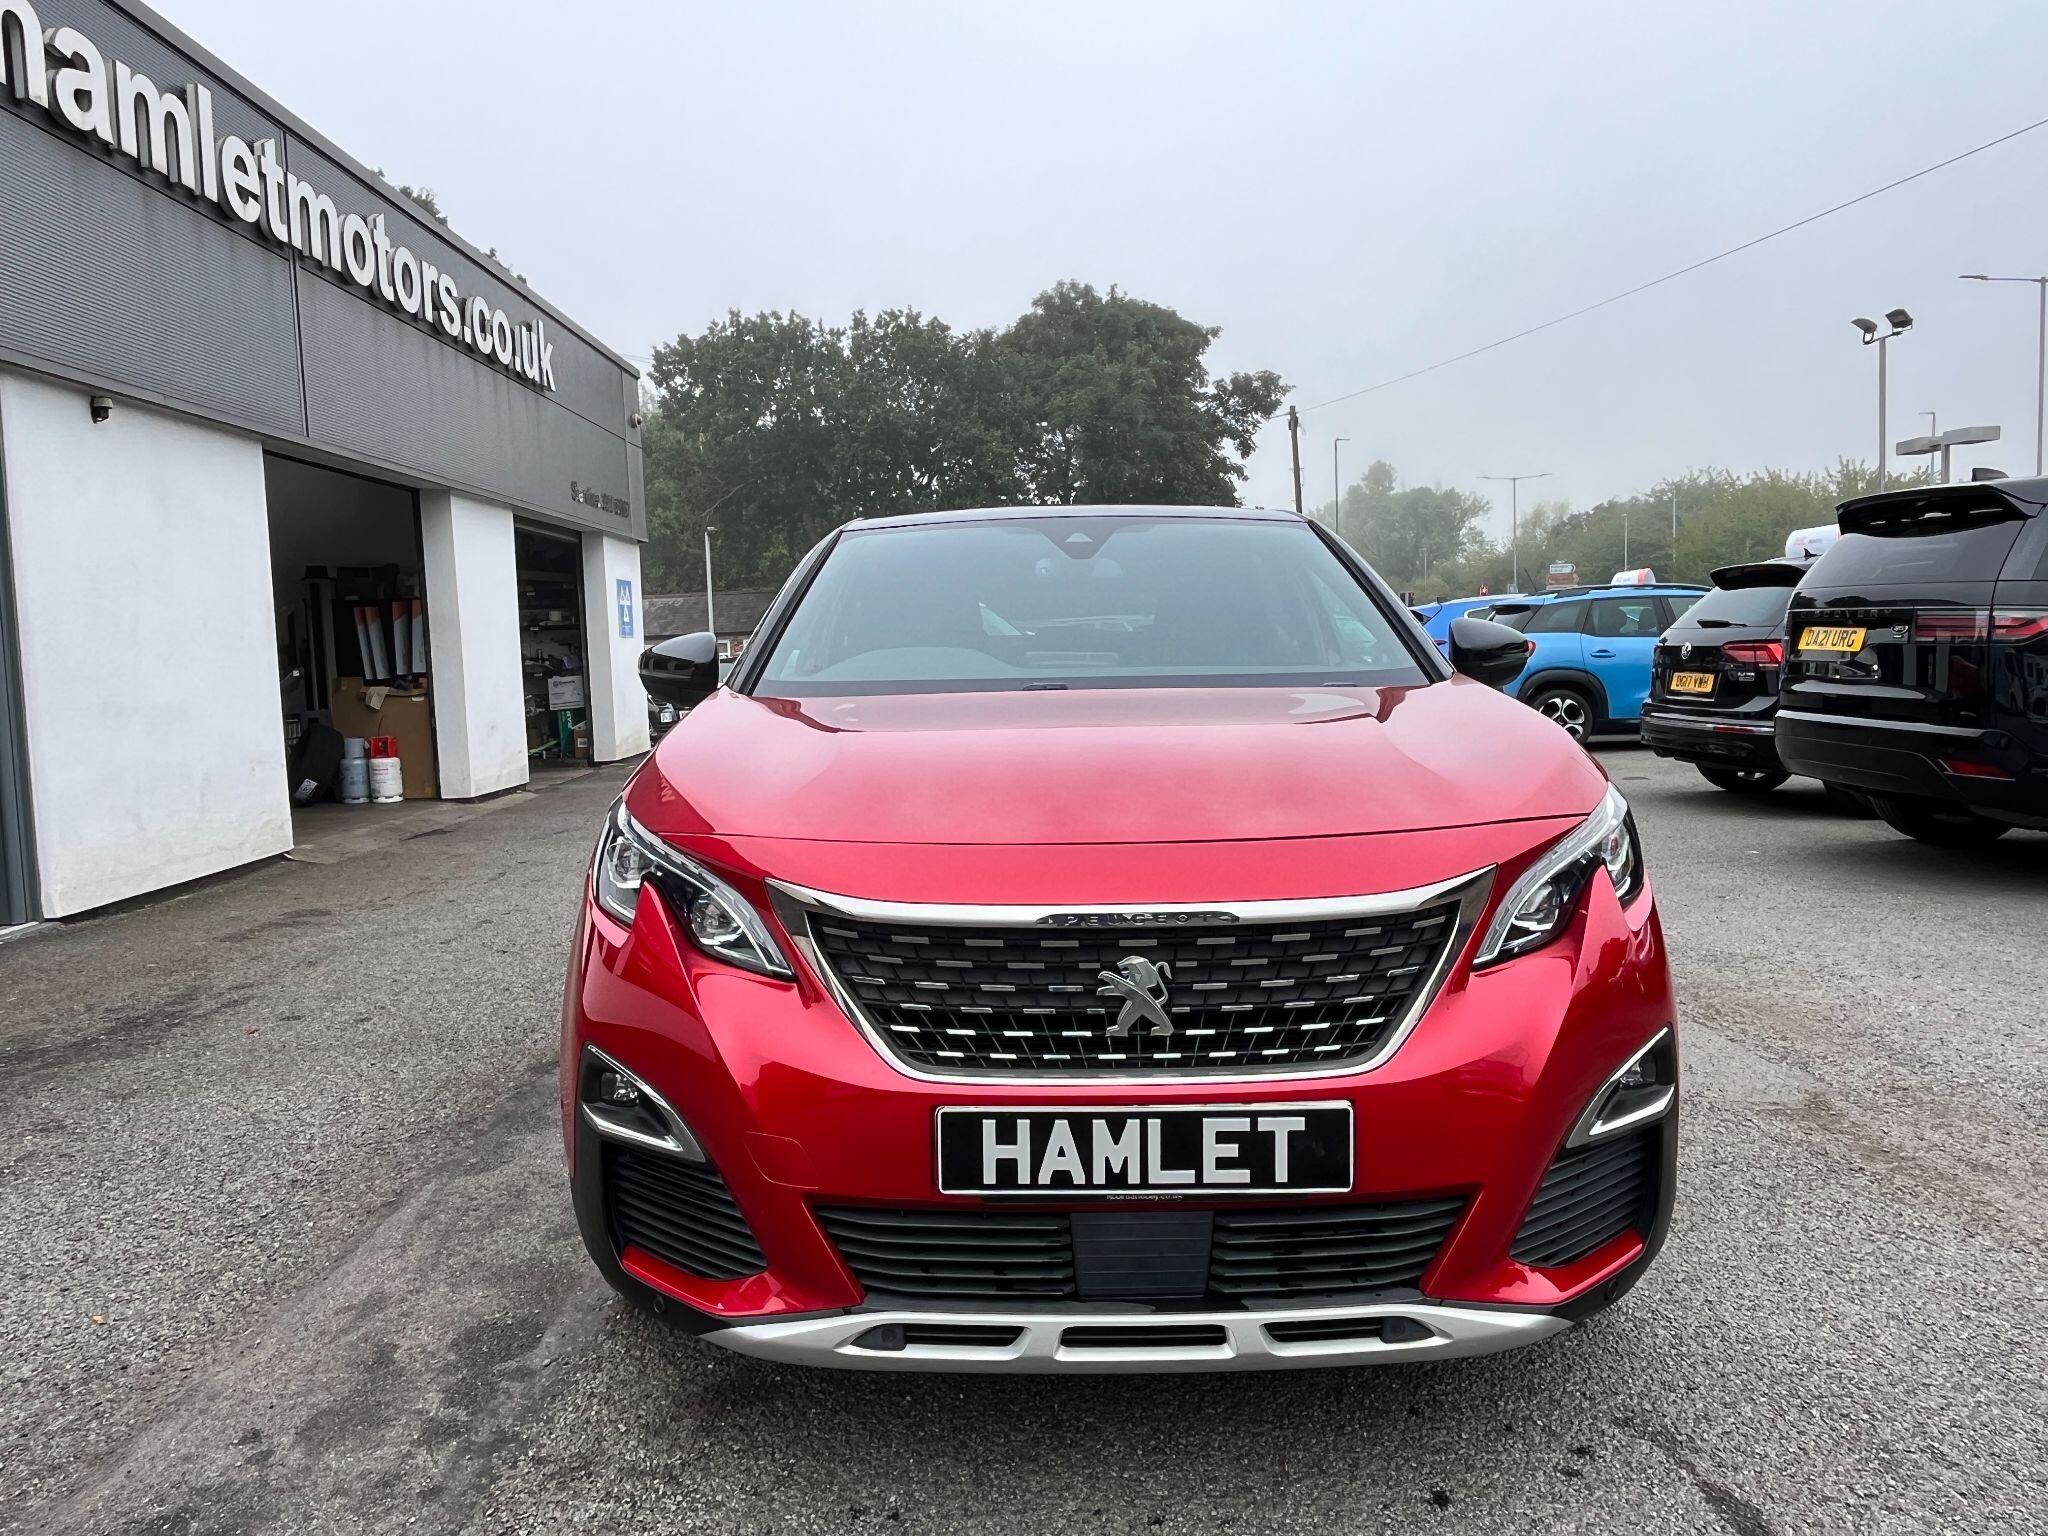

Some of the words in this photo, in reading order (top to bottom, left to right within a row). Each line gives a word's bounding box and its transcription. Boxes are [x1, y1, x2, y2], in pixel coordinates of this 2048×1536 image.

[1801, 607, 1893, 619] DSCOVERY
[1804, 629, 1831, 647] DA21
[1066, 912, 1214, 927] PEUGEOT
[982, 1116, 1306, 1185] HAMLET
